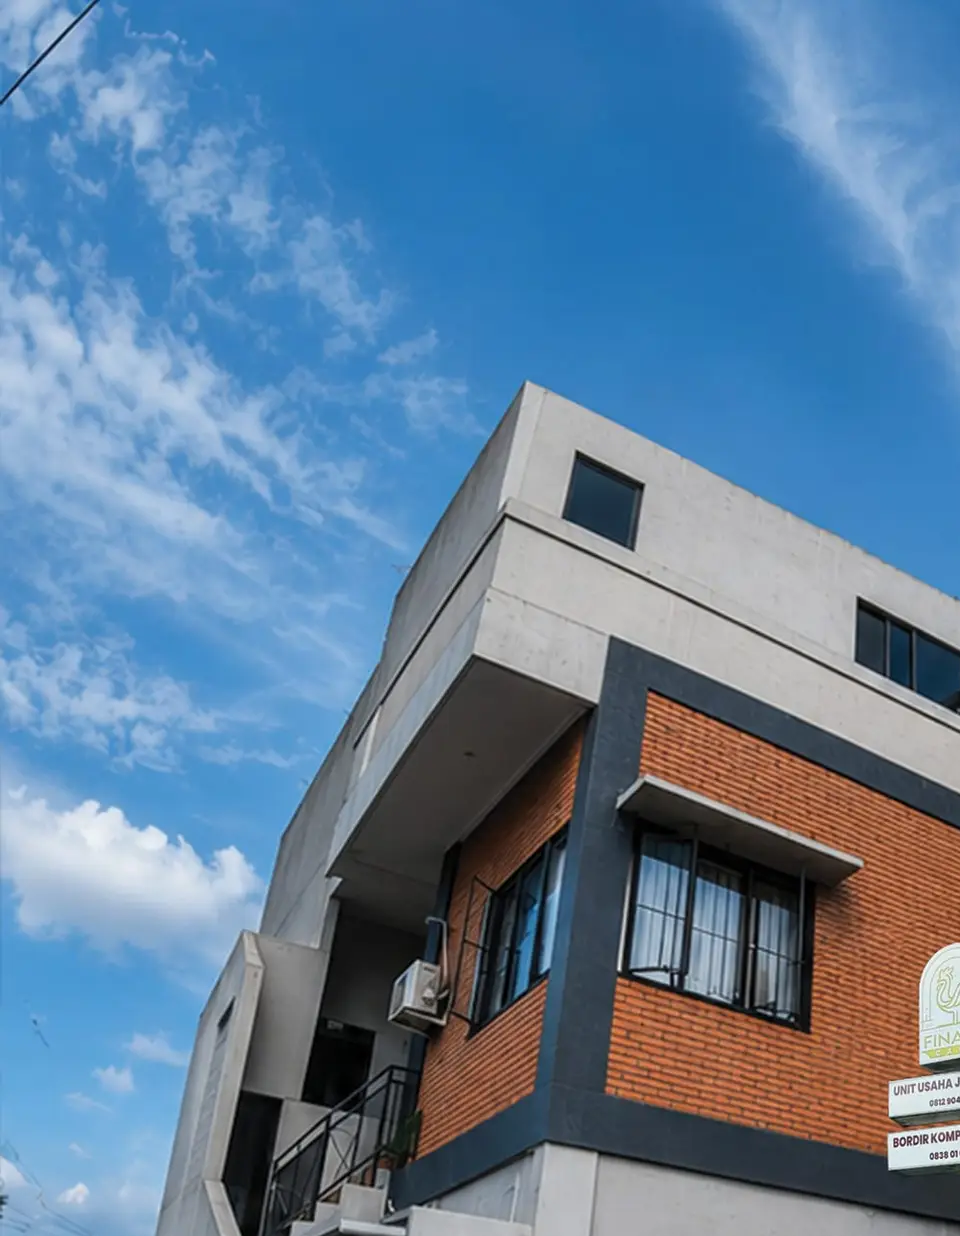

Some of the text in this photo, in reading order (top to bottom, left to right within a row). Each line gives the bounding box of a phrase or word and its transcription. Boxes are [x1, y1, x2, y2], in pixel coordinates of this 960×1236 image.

[893, 1083, 916, 1096] UNIT
[917, 1078, 953, 1093] USAHA
[929, 1098, 946, 1107] 0812
[893, 1133, 929, 1148] BORDIR
[929, 1151, 948, 1160] 0838
